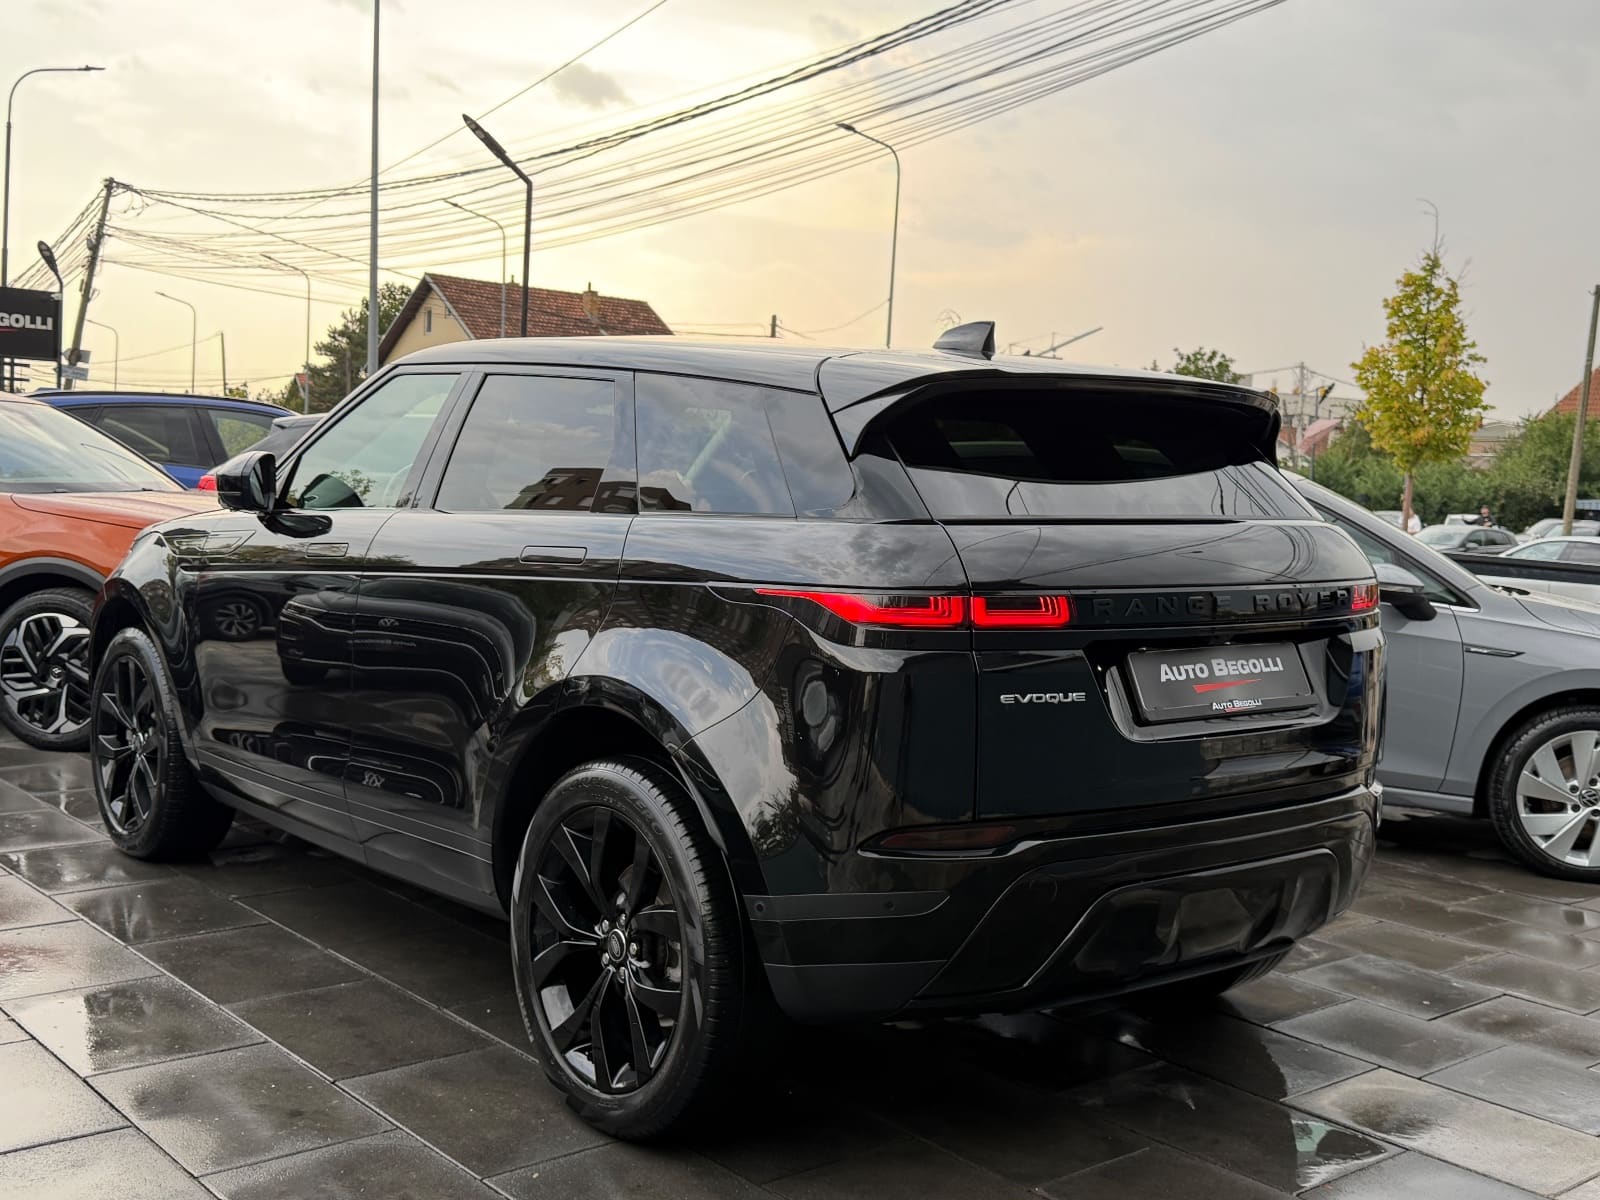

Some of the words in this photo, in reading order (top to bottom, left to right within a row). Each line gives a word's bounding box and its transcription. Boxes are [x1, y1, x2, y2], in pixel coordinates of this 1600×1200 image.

[1091, 594, 1233, 618] RANGE
[1253, 588, 1350, 613] ROVER
[1000, 692, 1087, 704] EVOQUE
